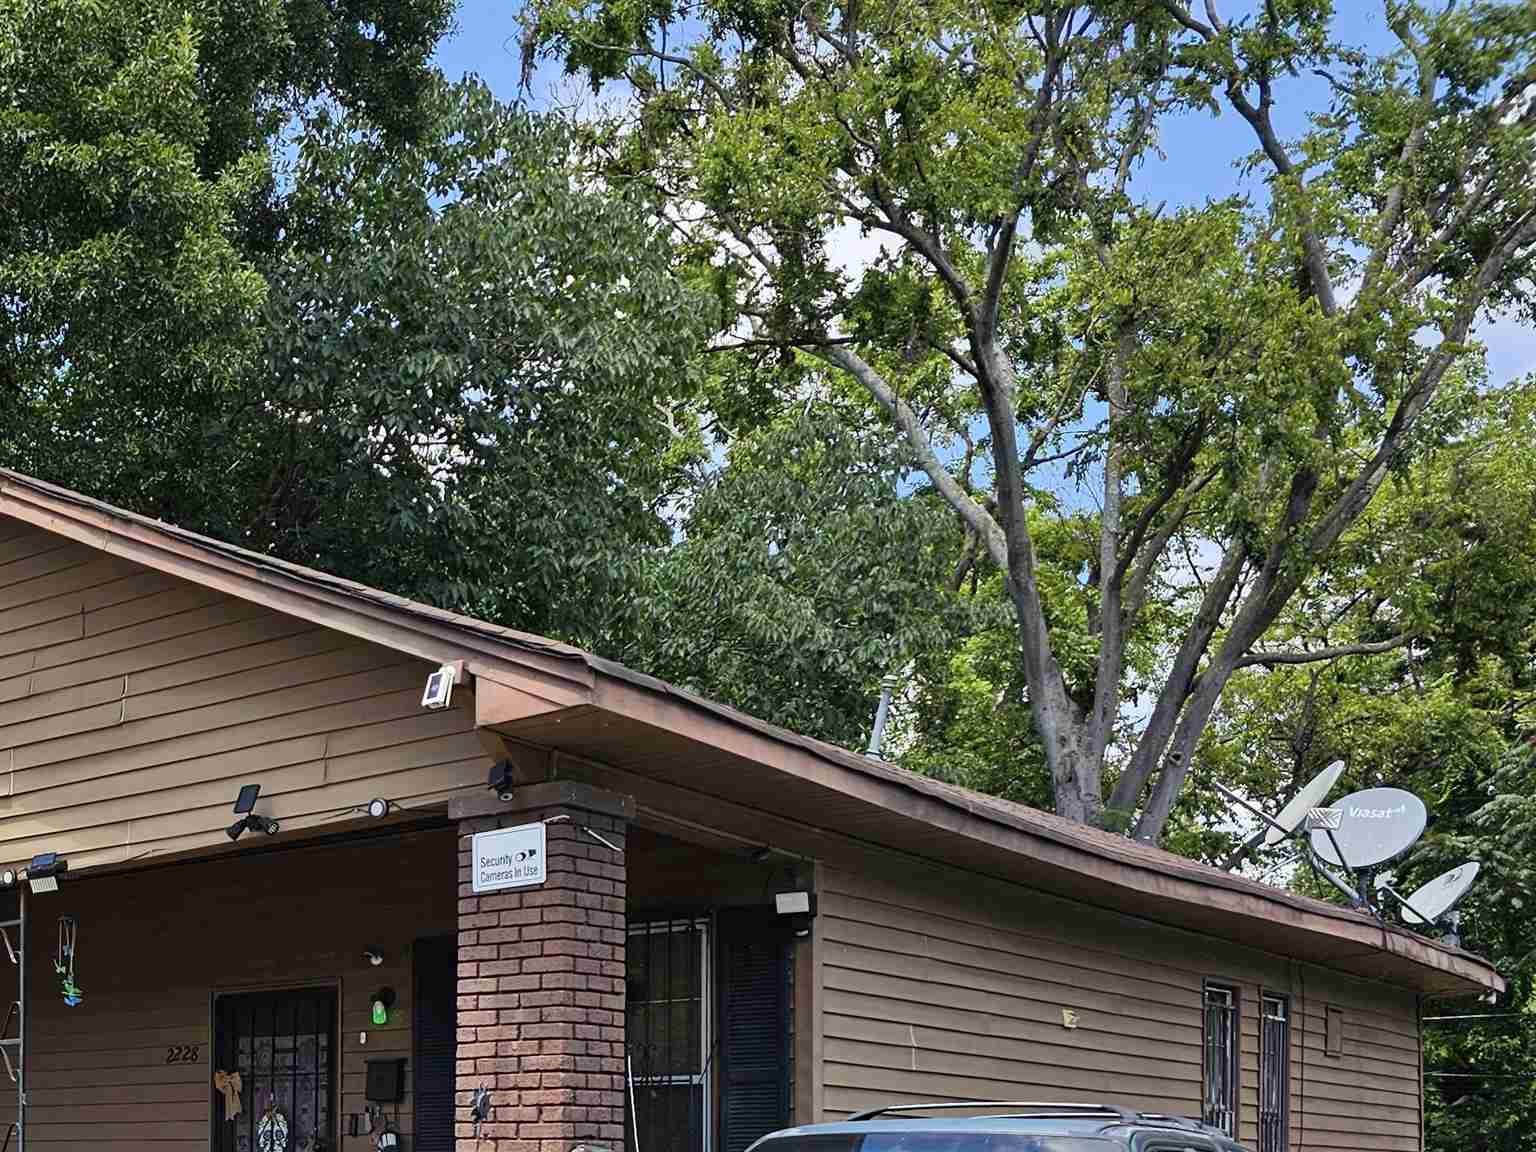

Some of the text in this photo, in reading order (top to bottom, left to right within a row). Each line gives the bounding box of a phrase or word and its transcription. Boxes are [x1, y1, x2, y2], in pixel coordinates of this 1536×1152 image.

[1349, 806, 1392, 818] Viasat
[480, 855, 513, 868] Security
[480, 870, 513, 881] Cameras
[524, 864, 538, 876] Use
[167, 1046, 199, 1063] 2228
